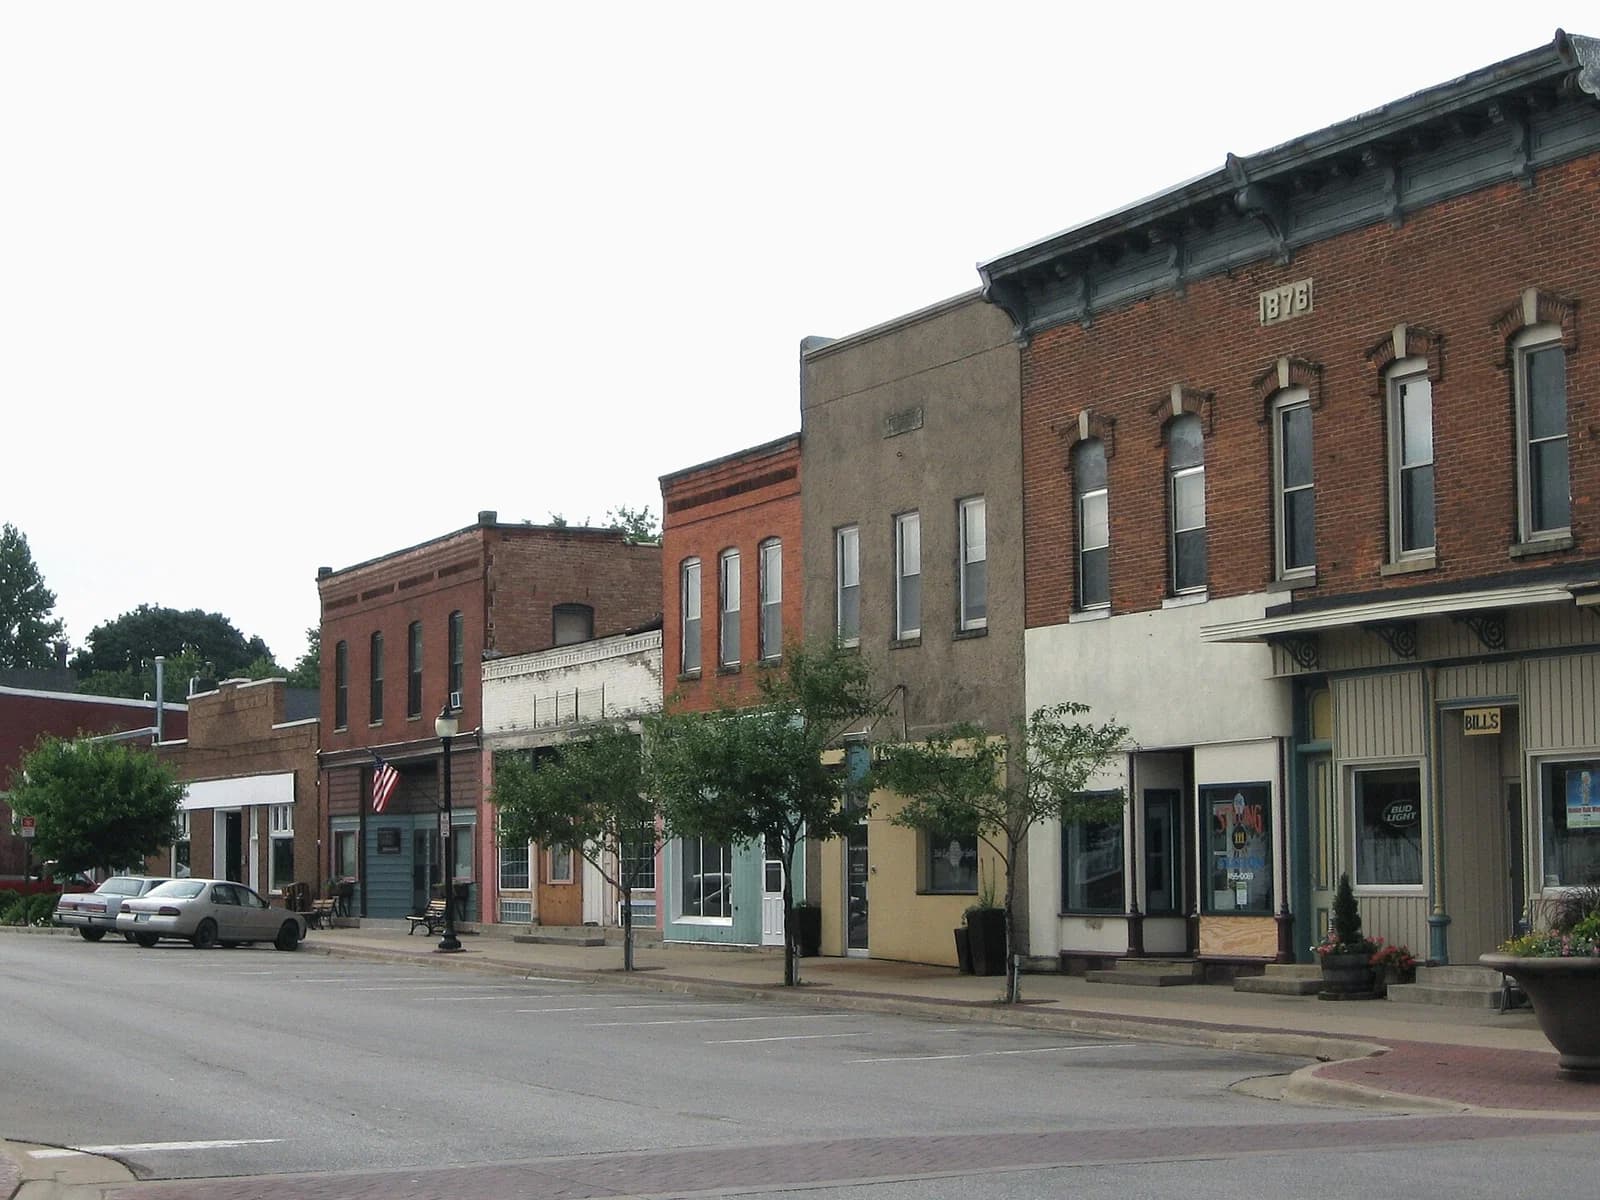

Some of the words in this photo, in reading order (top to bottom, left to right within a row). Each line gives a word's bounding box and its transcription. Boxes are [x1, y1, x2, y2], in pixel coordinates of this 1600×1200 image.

[1260, 282, 1309, 322] 1876
[1465, 711, 1499, 730] BILL'S
[1215, 804, 1264, 833] STING
[1387, 811, 1417, 822] LIGHT
[1391, 804, 1413, 814] BUD
